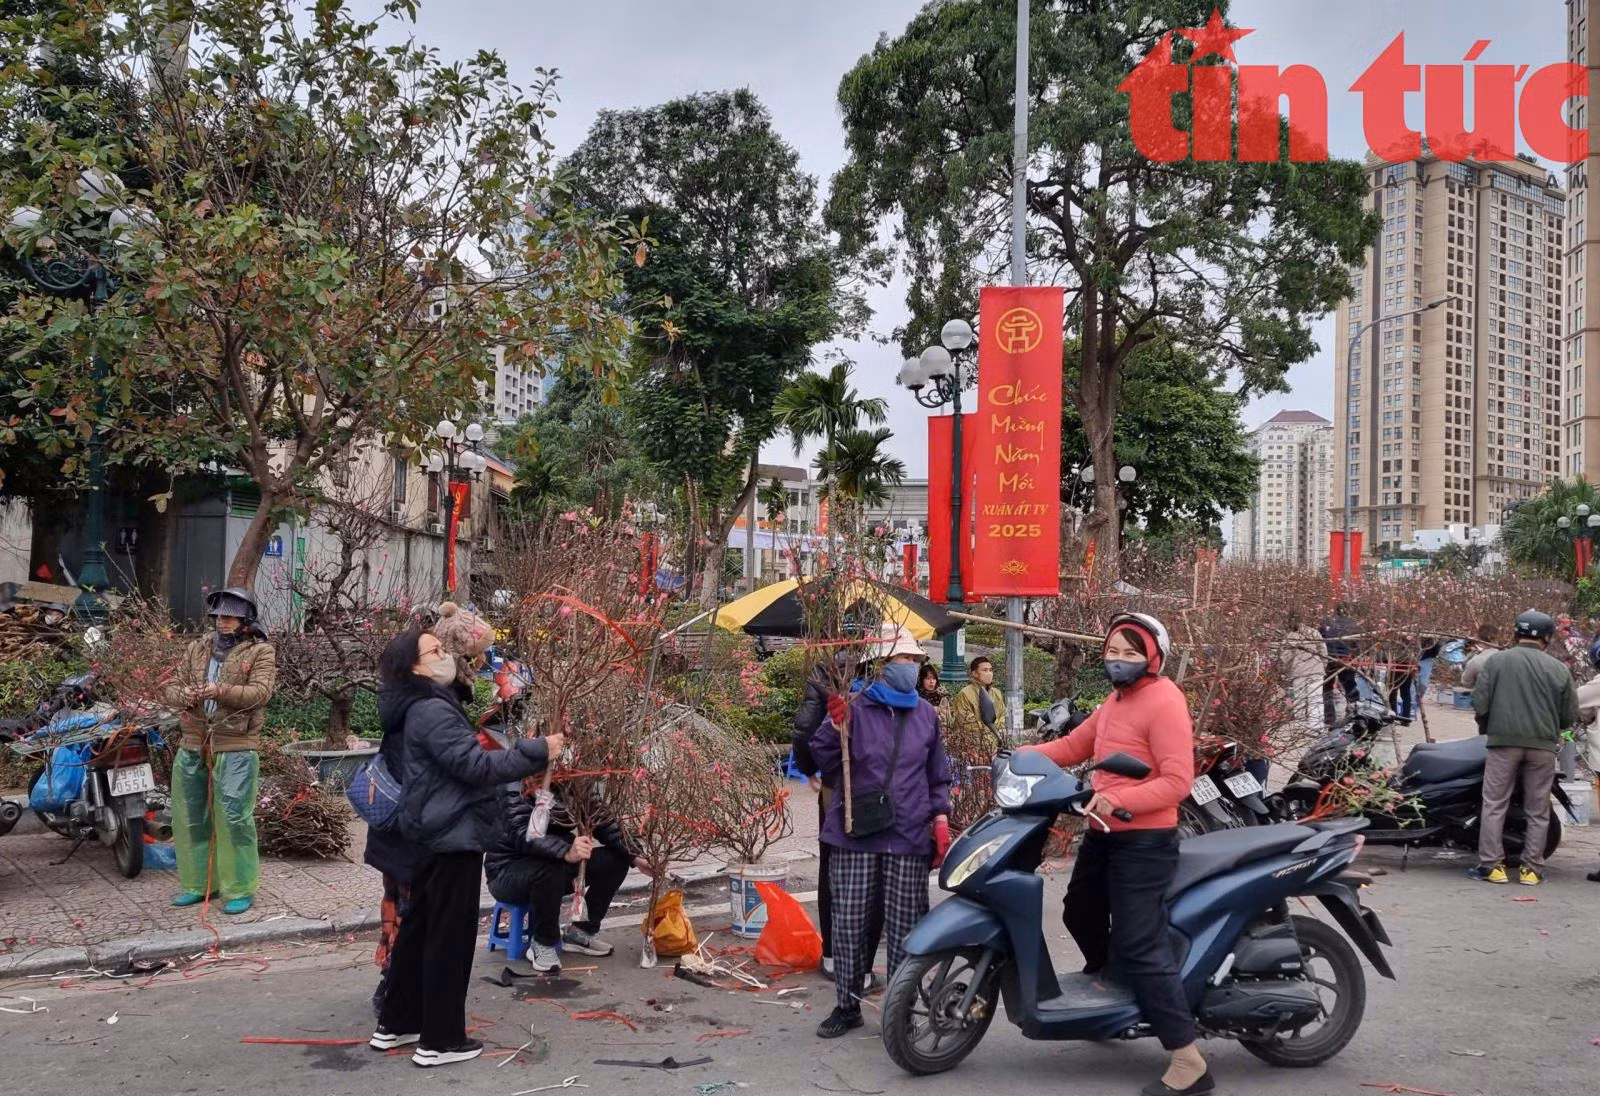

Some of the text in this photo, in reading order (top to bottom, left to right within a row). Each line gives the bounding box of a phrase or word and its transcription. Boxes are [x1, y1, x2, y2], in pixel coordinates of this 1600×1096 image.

[988, 379, 1047, 406] Chúc
[992, 413, 1044, 451] Mừng
[995, 443, 1040, 467] Năm
[1000, 472, 1035, 493] Mới
[988, 524, 1042, 537] 2025
